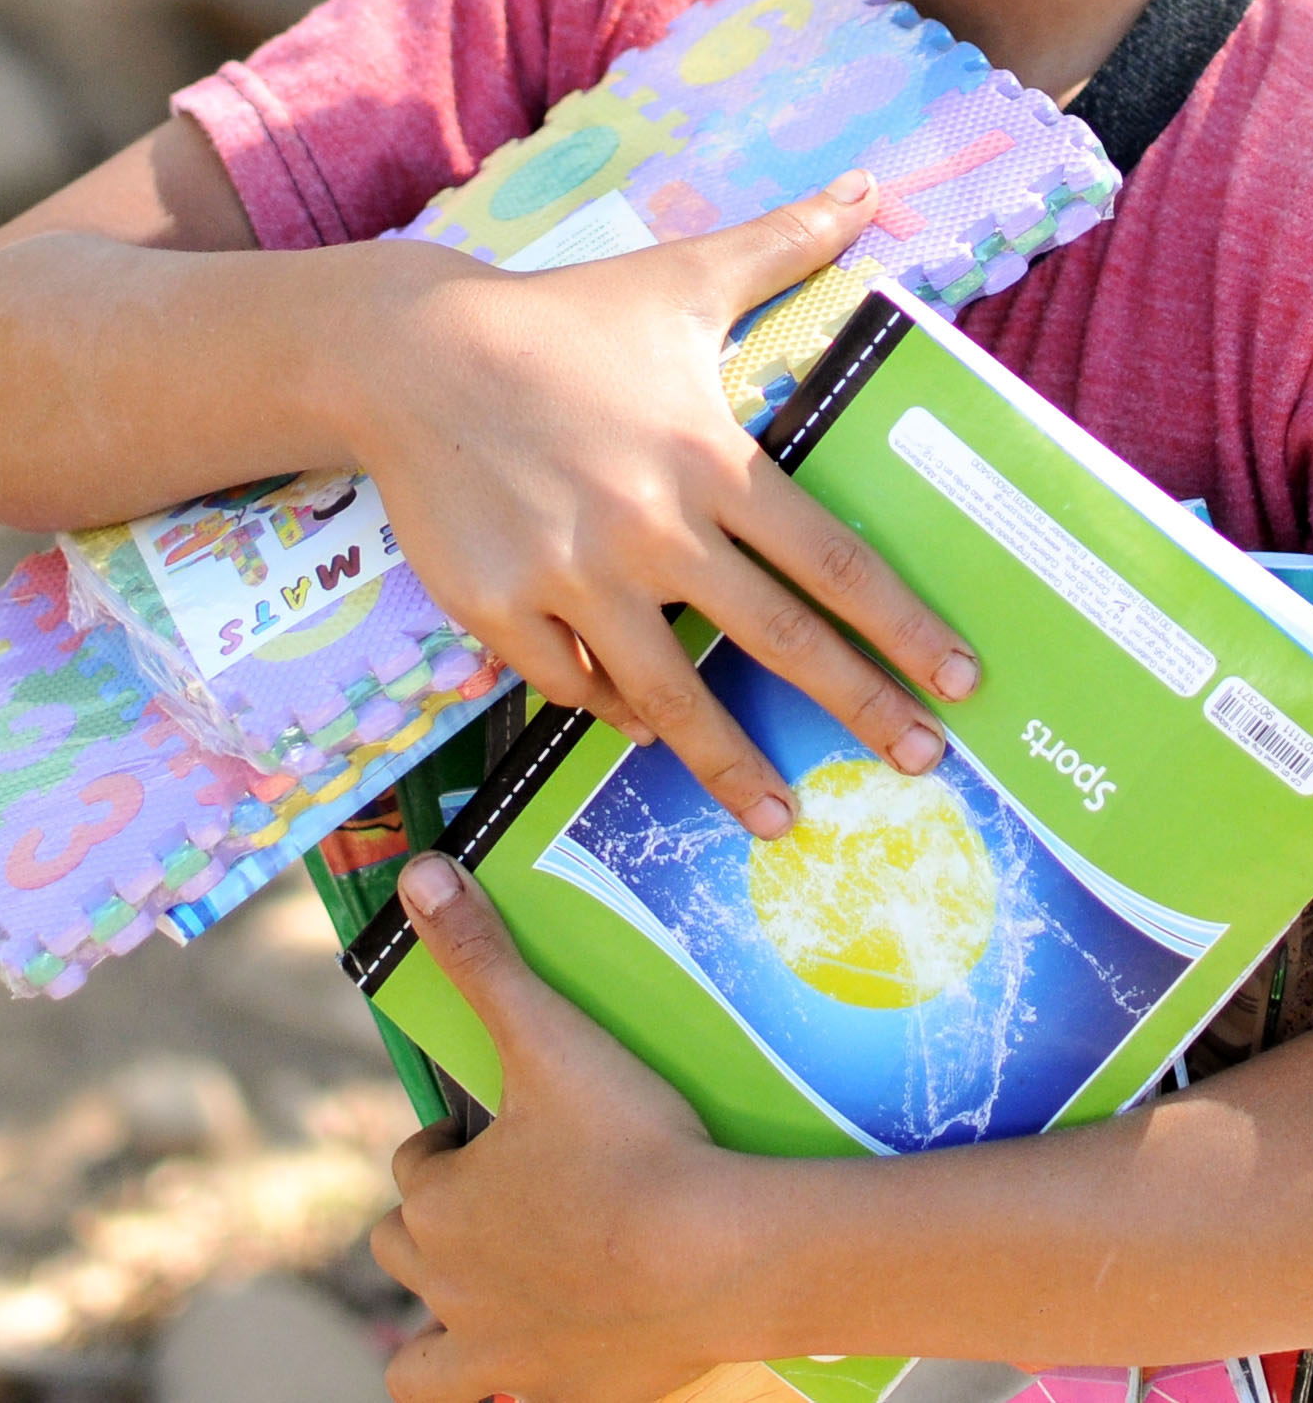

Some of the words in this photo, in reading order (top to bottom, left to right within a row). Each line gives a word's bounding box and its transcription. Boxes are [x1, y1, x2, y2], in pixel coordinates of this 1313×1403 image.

[218, 544, 361, 656] MATS
[1120, 635, 1158, 668] Guatemala
[1235, 685, 1276, 721] 907371
[1021, 718, 1118, 812] Sports
